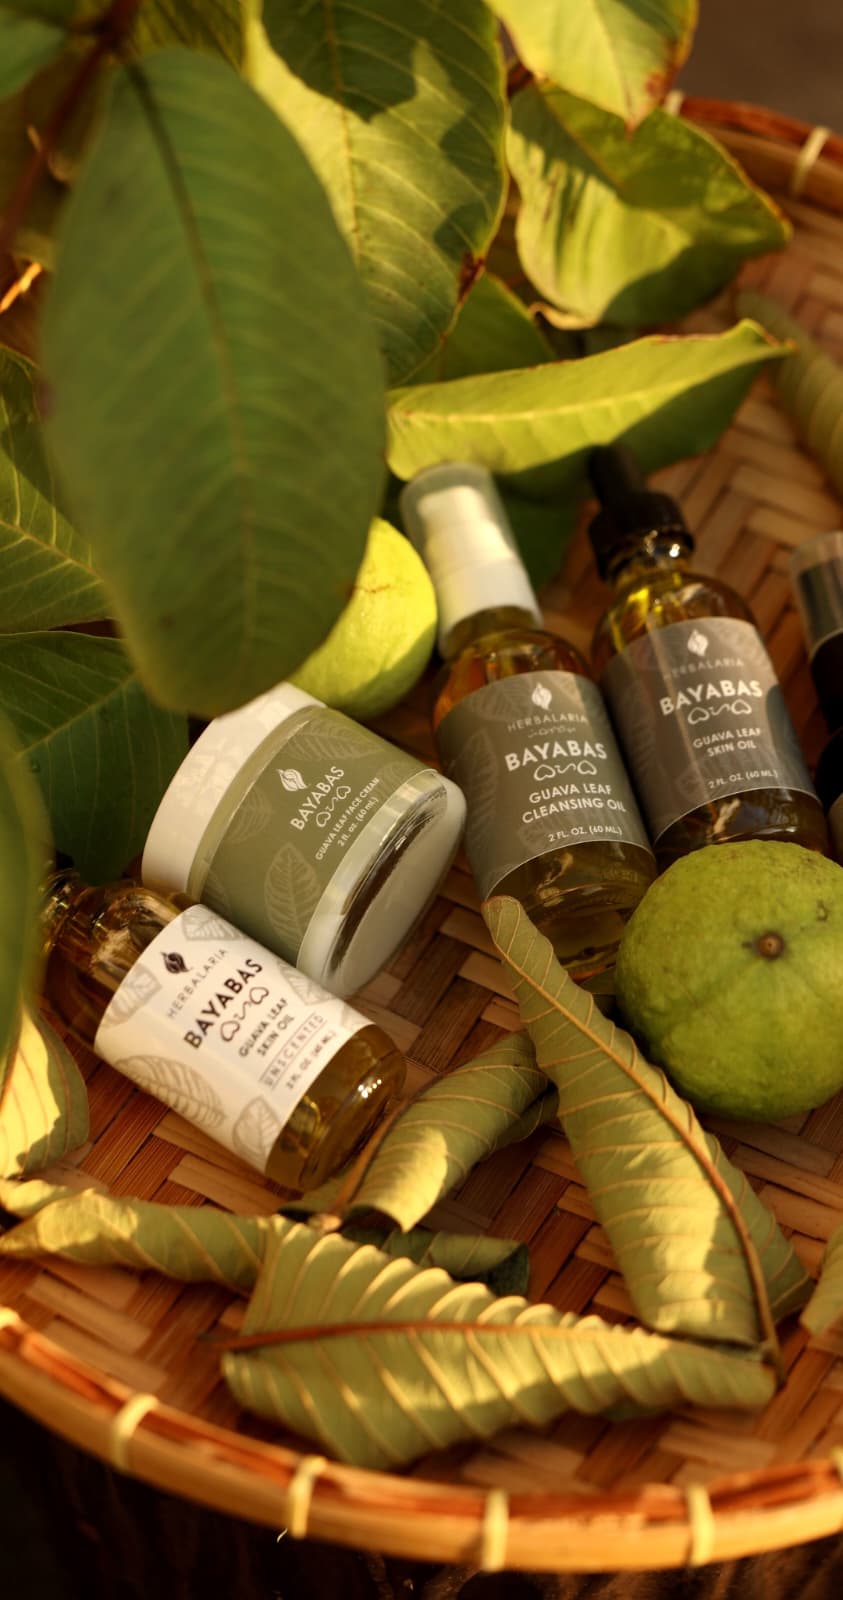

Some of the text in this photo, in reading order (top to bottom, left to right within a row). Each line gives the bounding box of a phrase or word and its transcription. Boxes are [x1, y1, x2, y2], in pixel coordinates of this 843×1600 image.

[663, 657, 745, 680] ERBALARIA
[660, 680, 763, 716] BAYABAS
[507, 713, 589, 733] HERBALARIA
[693, 728, 761, 748] GUAVA LEAF
[504, 740, 608, 772] BAYABAS
[707, 740, 757, 757] SKIN OIL
[290, 766, 345, 831] BAYABAS
[529, 783, 612, 804] GUAVA LEAF
[708, 780, 715, 789] 2
[315, 777, 380, 860] GUAVA LEAF FACE CREAM
[522, 798, 627, 824] CLEANSING OIL
[548, 833, 555, 842] 2
[167, 948, 228, 1019] HERBALARIA
[183, 958, 263, 1049] BAYABAS
[238, 997, 289, 1057] GUAVA LEAF
[256, 1015, 295, 1057] SKIN OIL
[264, 1014, 325, 1086] UNSCENTED
